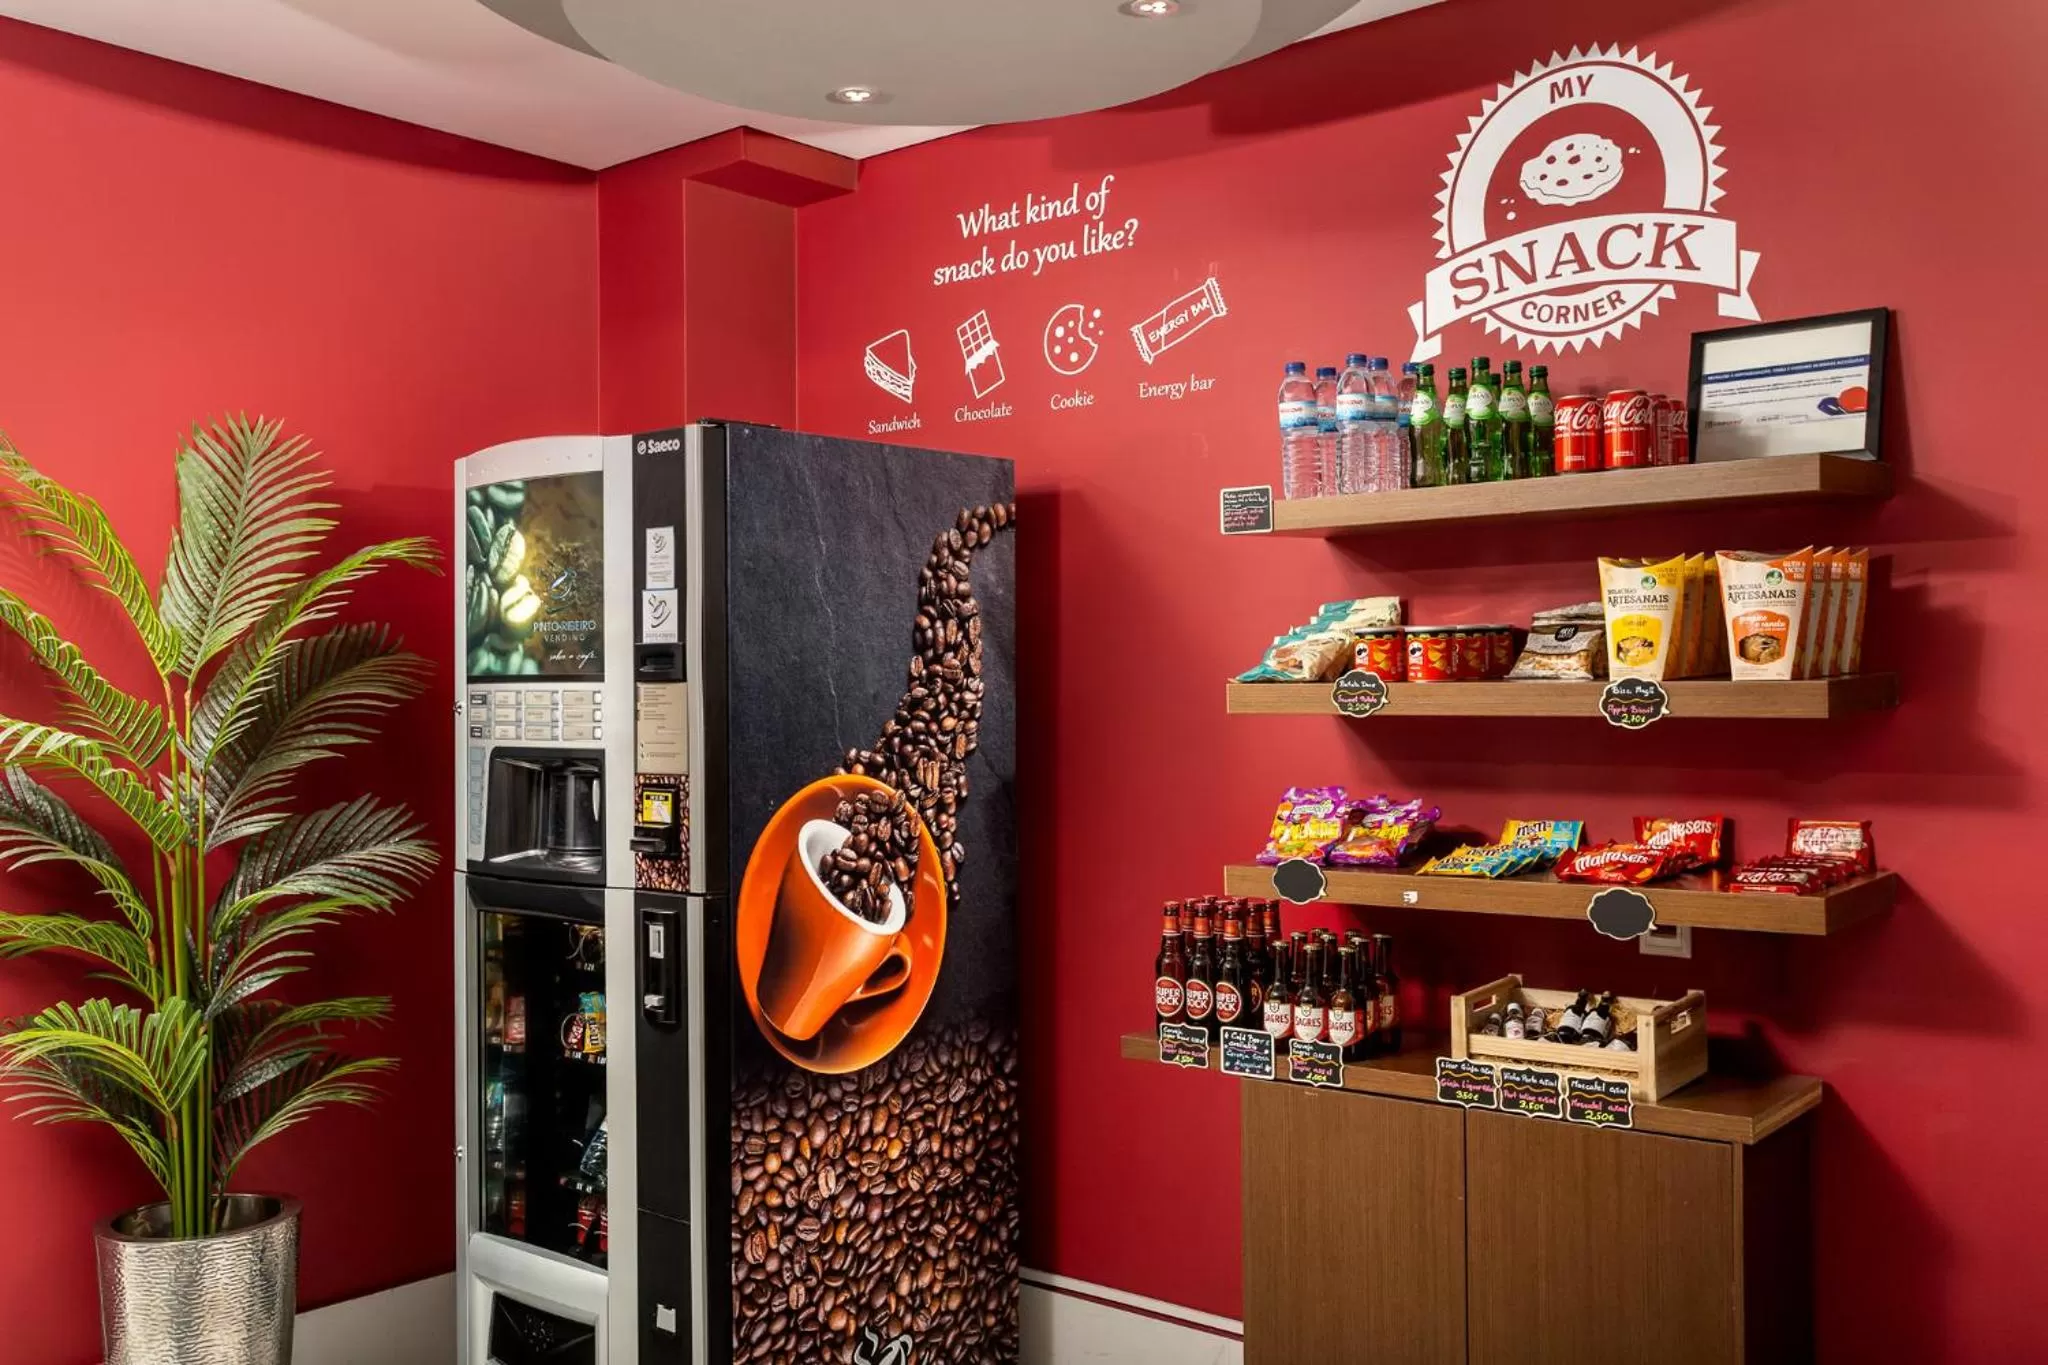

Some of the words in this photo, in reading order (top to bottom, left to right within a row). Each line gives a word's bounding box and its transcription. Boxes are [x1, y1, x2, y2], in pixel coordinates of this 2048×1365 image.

[1549, 73, 1595, 104] MY
[957, 203, 1020, 239] What
[1026, 182, 1080, 224] kind
[1085, 174, 1115, 219] of
[933, 250, 995, 286] snack
[1001, 241, 1028, 271] do
[1032, 239, 1077, 276] you
[1082, 218, 1139, 256] like?
[1449, 221, 1705, 311] SNACK
[1520, 288, 1628, 326] CORNER
[1148, 309, 1189, 343] ENERGY
[1190, 297, 1211, 317] BAR
[1138, 376, 1187, 402] Energy
[1190, 373, 1215, 393] bar
[1050, 391, 1095, 410] Cookie
[954, 402, 1013, 424] Chocolate
[868, 414, 921, 435] Sandwich
[647, 438, 680, 454] Saeco
[1607, 594, 1670, 608] ARTESANAIS
[1727, 589, 1797, 604] ARTESANAIS
[544, 633, 586, 642] VENDING
[1571, 1080, 1606, 1092] Moscatel
